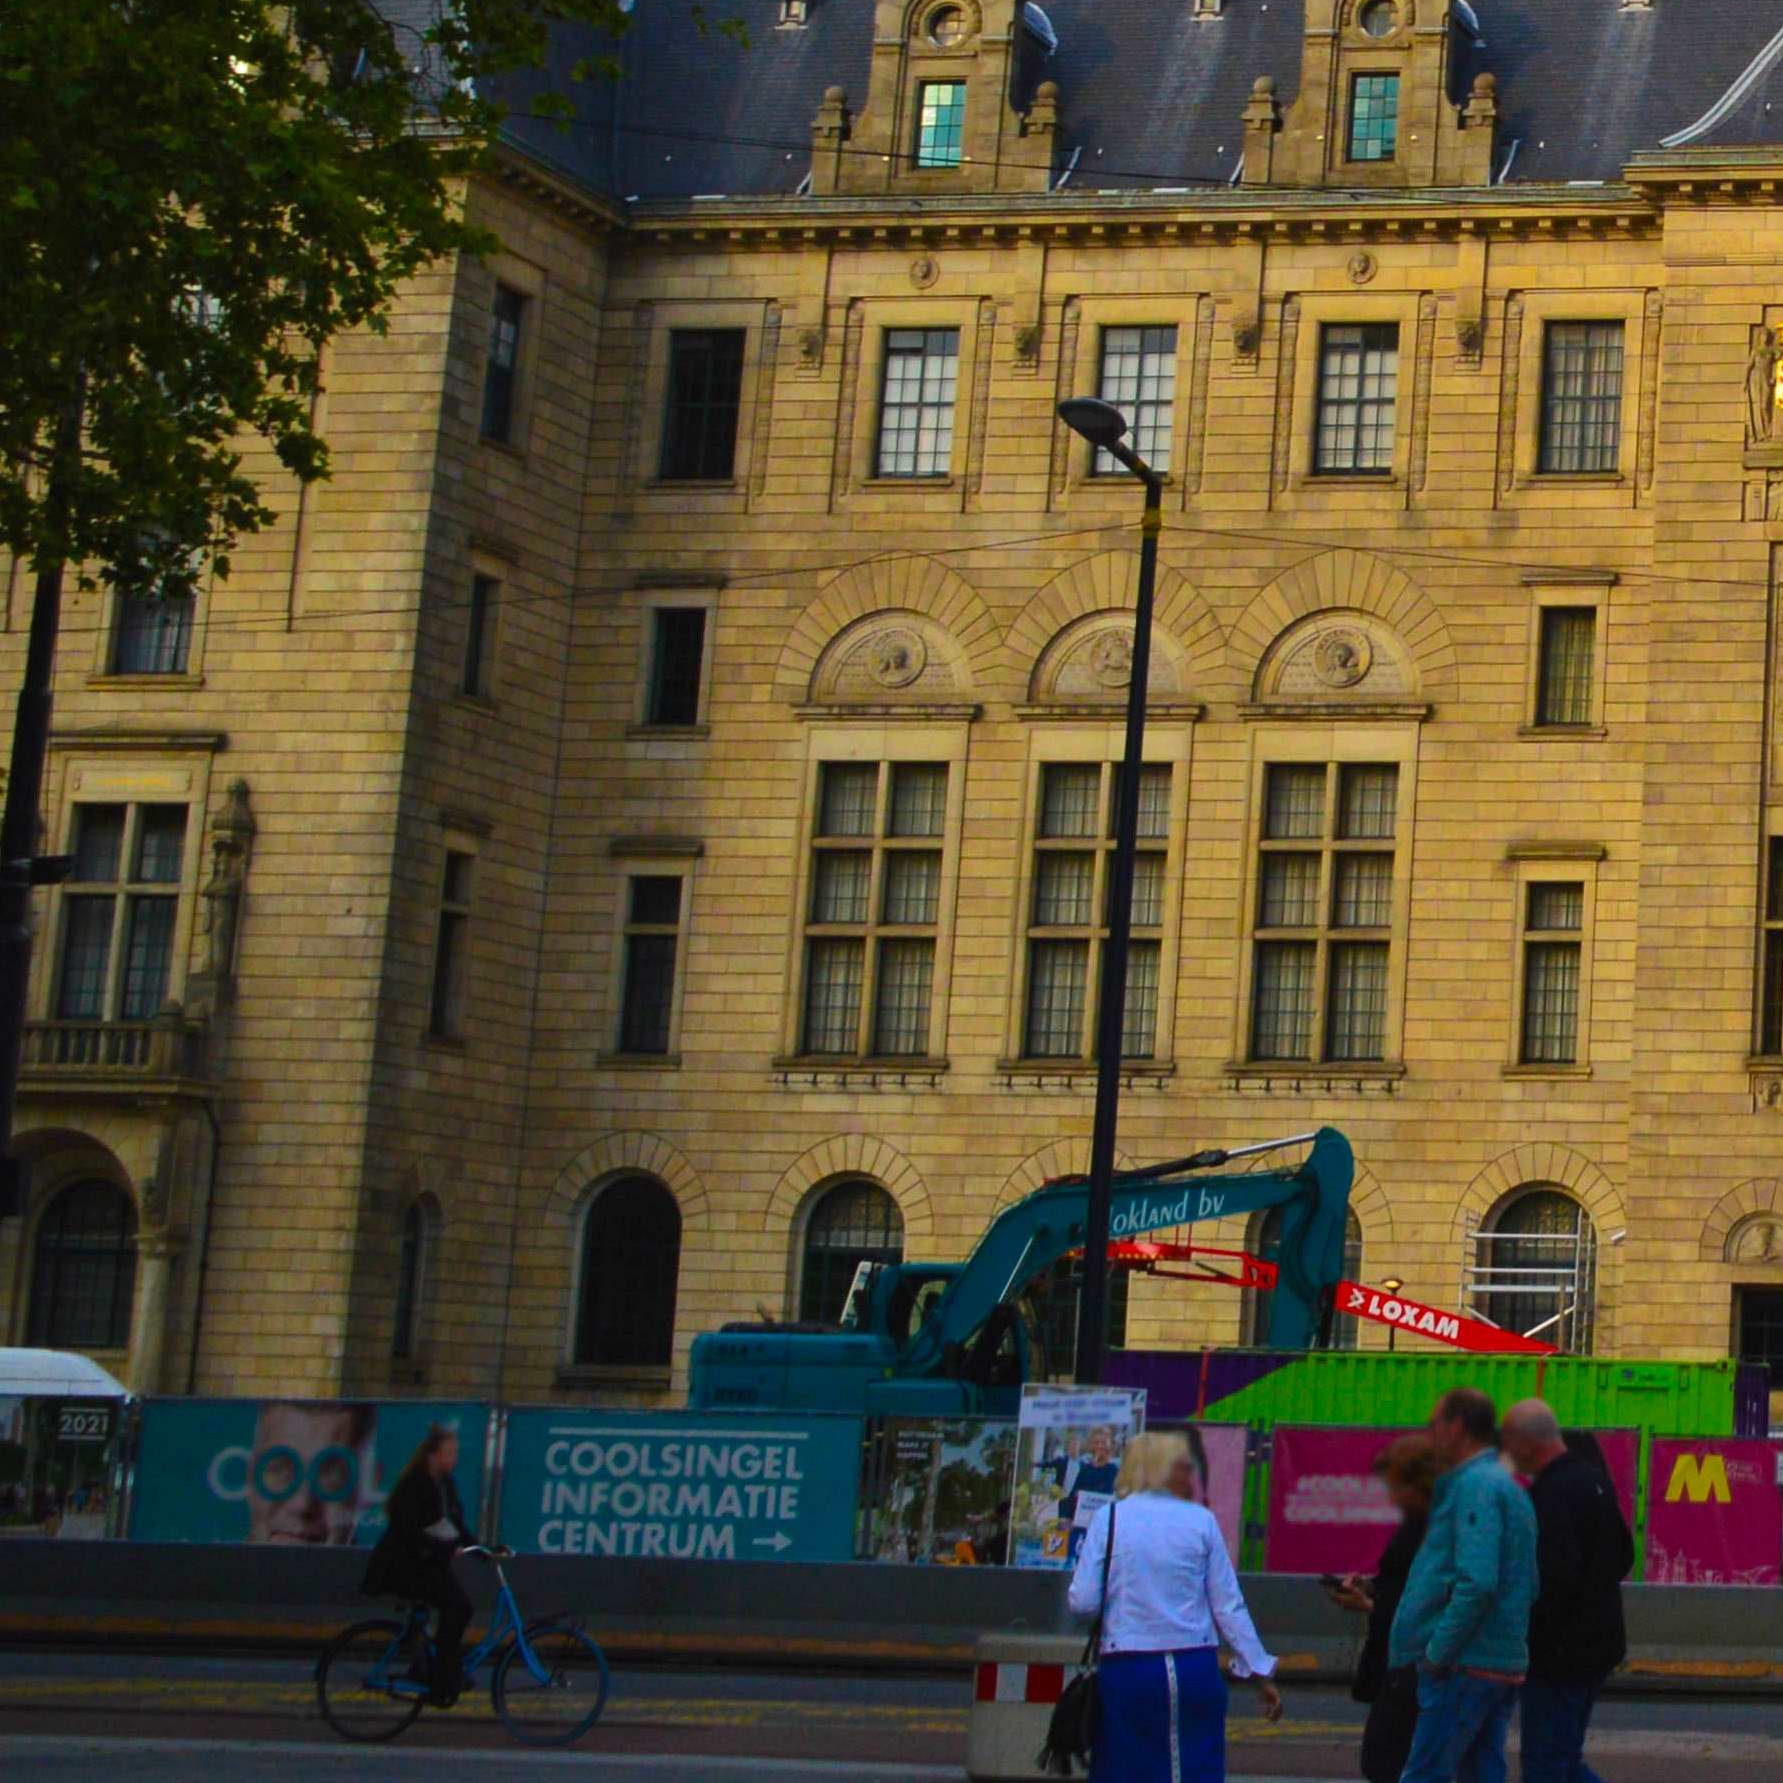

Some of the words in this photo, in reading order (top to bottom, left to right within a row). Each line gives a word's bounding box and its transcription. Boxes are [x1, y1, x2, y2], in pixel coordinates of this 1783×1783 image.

[1368, 1294, 1460, 1340] LOXAM
[57, 1413, 109, 1435] 2021
[208, 1443, 390, 1503] COOL
[544, 1441, 804, 1482] COOLSINGEL
[539, 1480, 799, 1521] INFORMATIE
[537, 1519, 736, 1560] CENTRUM
